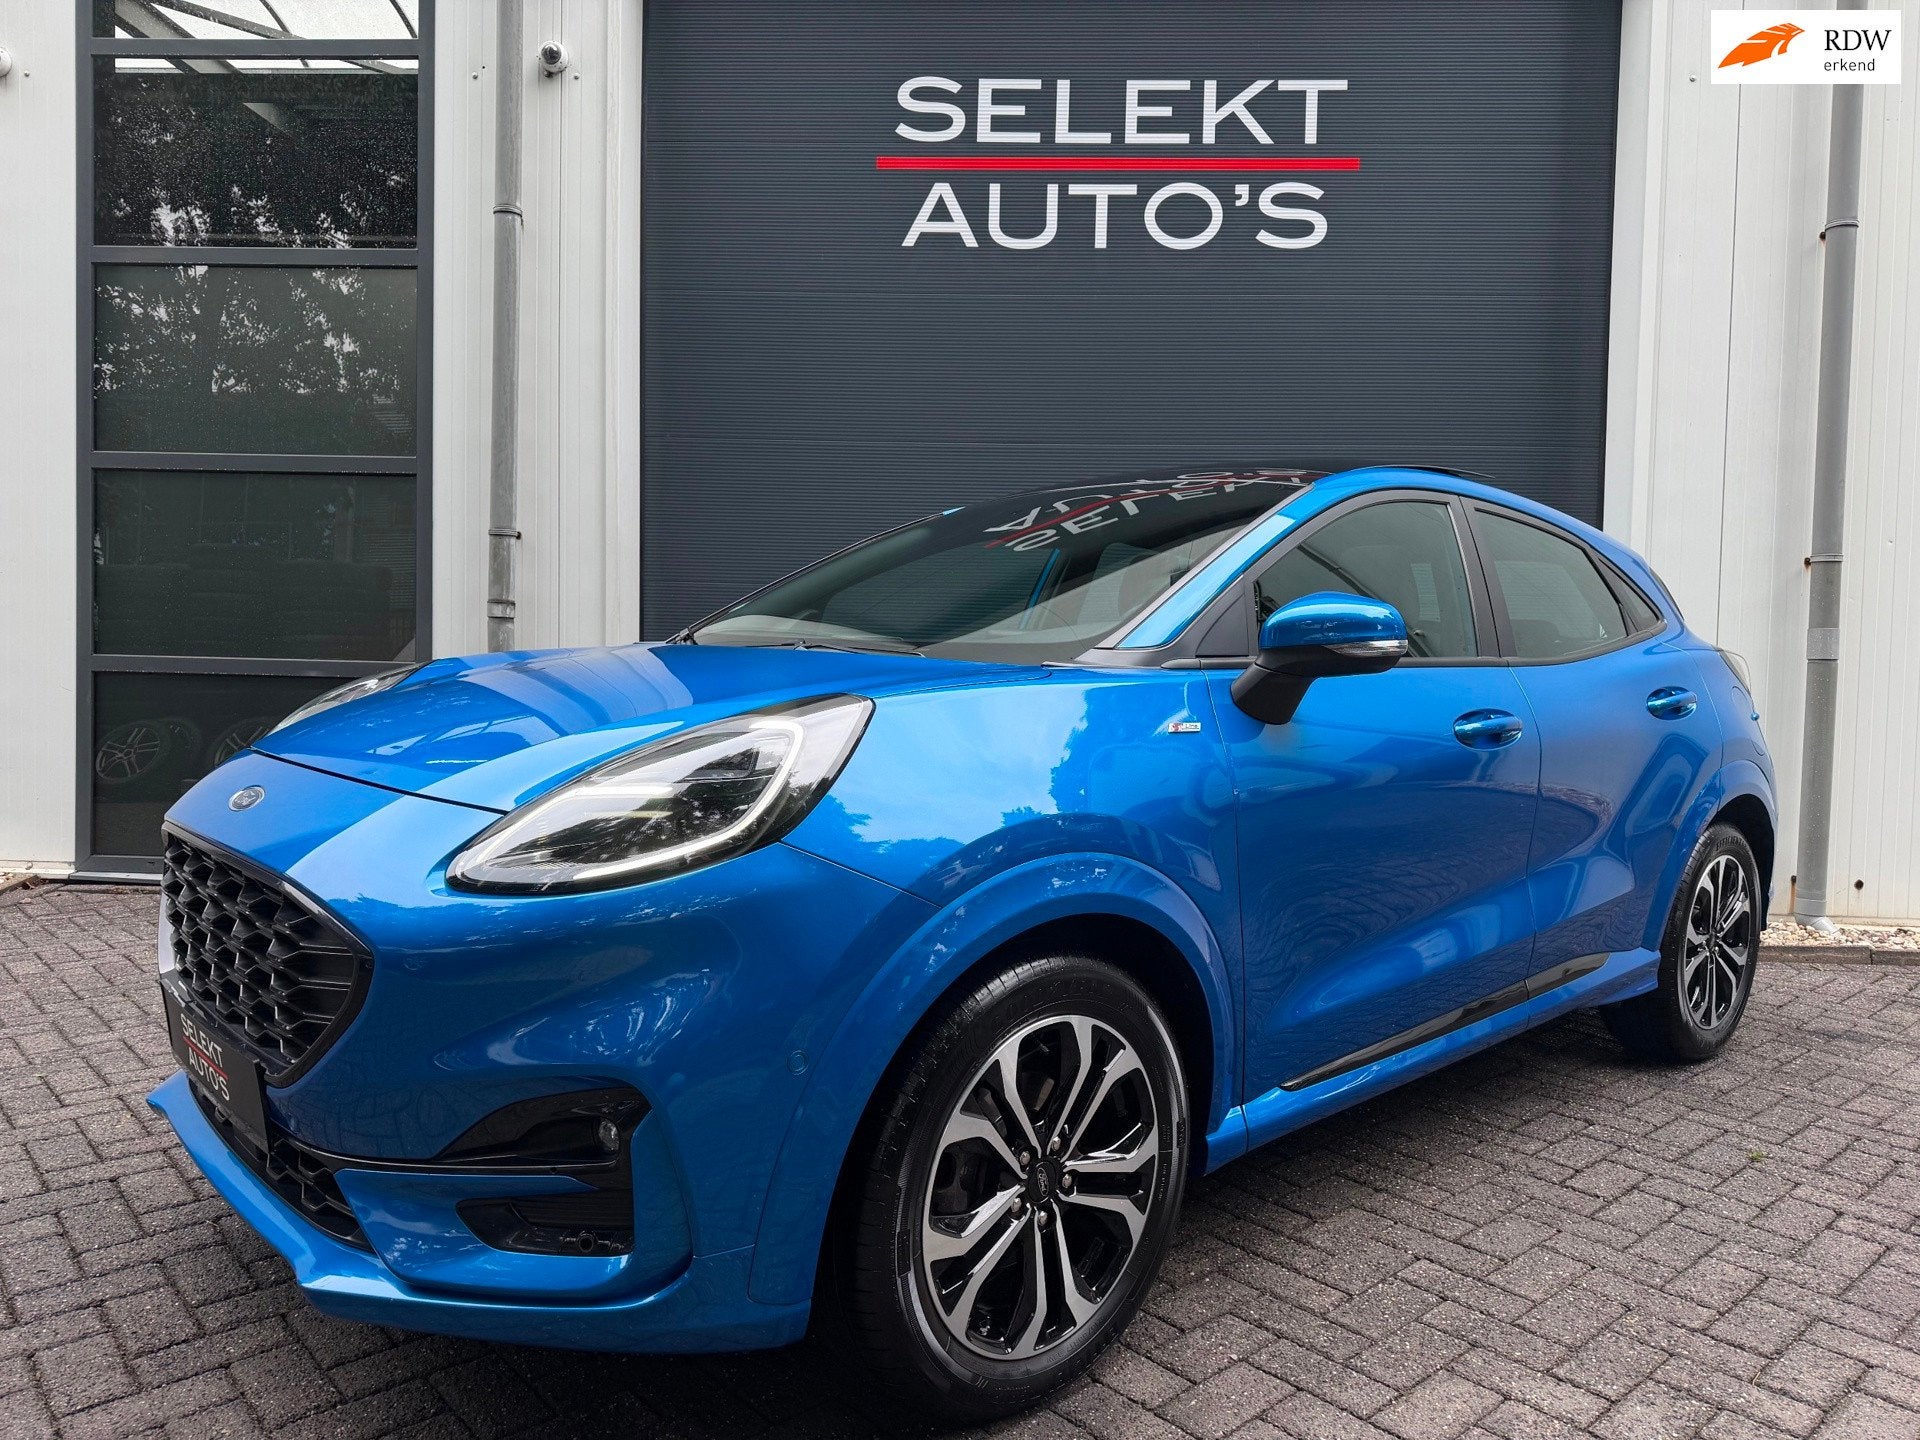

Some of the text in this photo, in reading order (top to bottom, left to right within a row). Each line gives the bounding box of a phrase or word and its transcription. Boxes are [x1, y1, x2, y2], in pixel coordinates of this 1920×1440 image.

[895, 76, 1348, 144] SELEKT
[901, 182, 1328, 250] AUTO'S
[180, 1013, 223, 1068] SELEKT
[188, 1046, 230, 1101] AUTO'S
